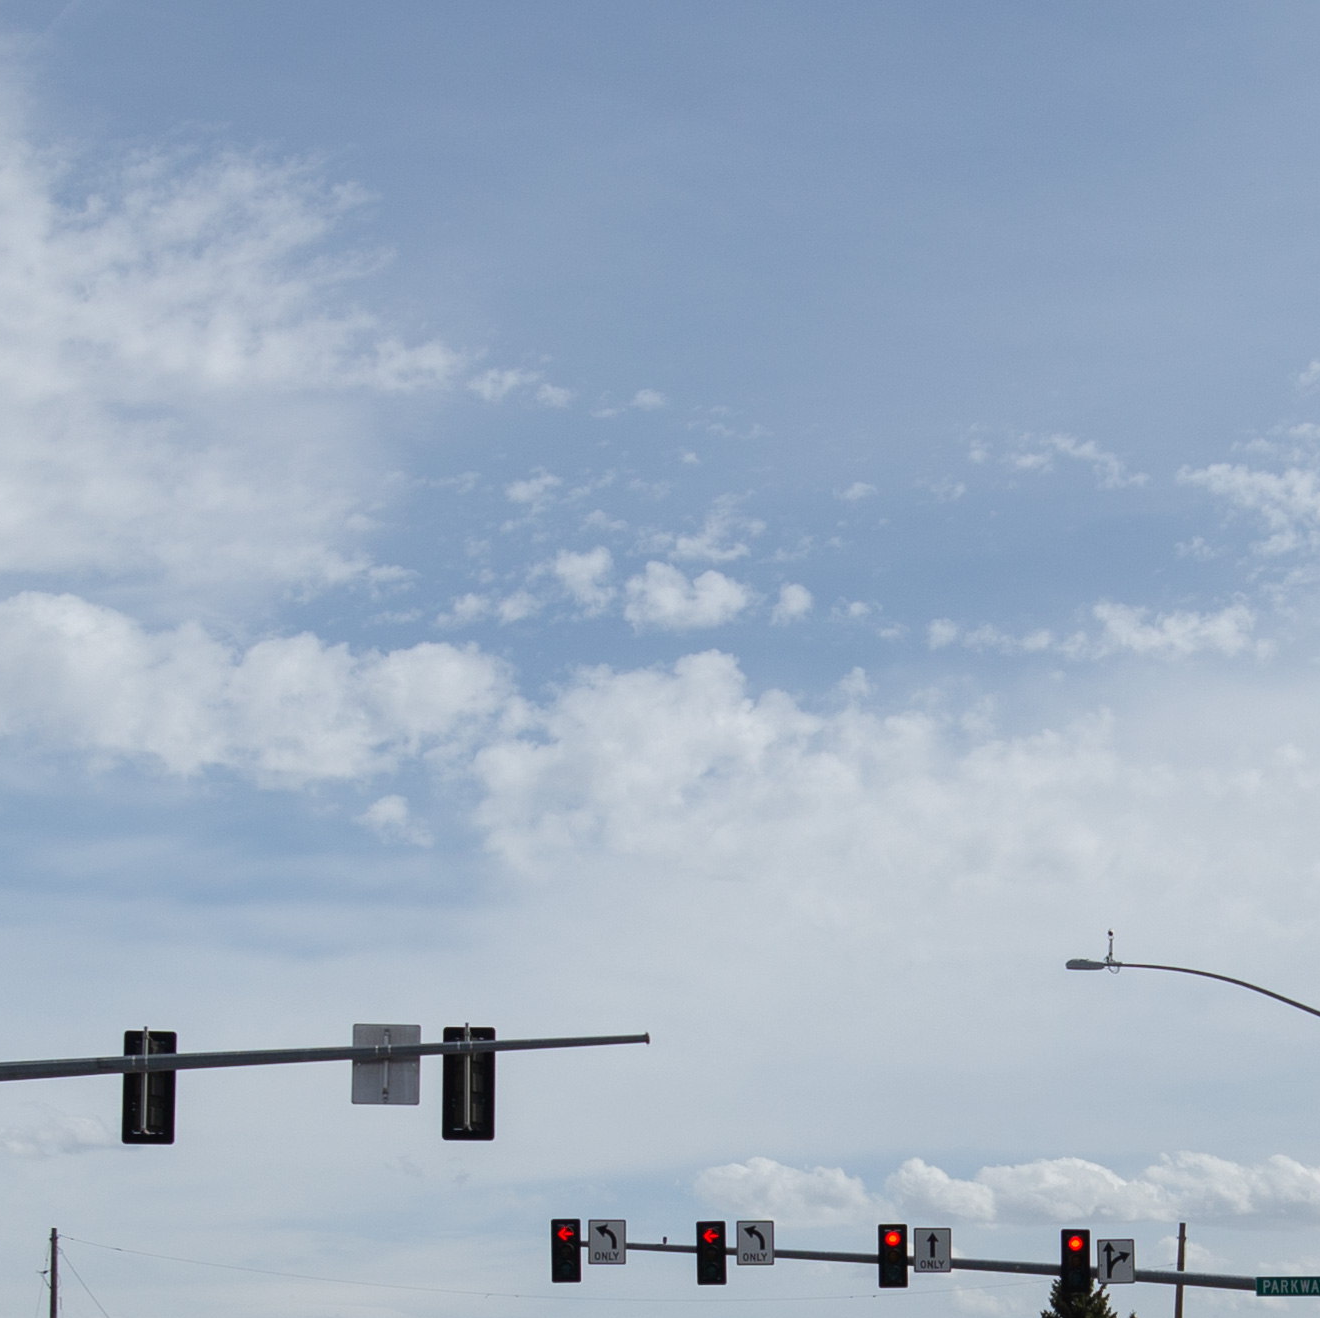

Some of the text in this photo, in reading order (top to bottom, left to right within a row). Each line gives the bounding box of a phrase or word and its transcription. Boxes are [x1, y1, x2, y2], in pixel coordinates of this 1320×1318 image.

[594, 1252, 619, 1261] ONLY
[743, 1253, 768, 1262] ONLY
[920, 1260, 945, 1269] ONLY
